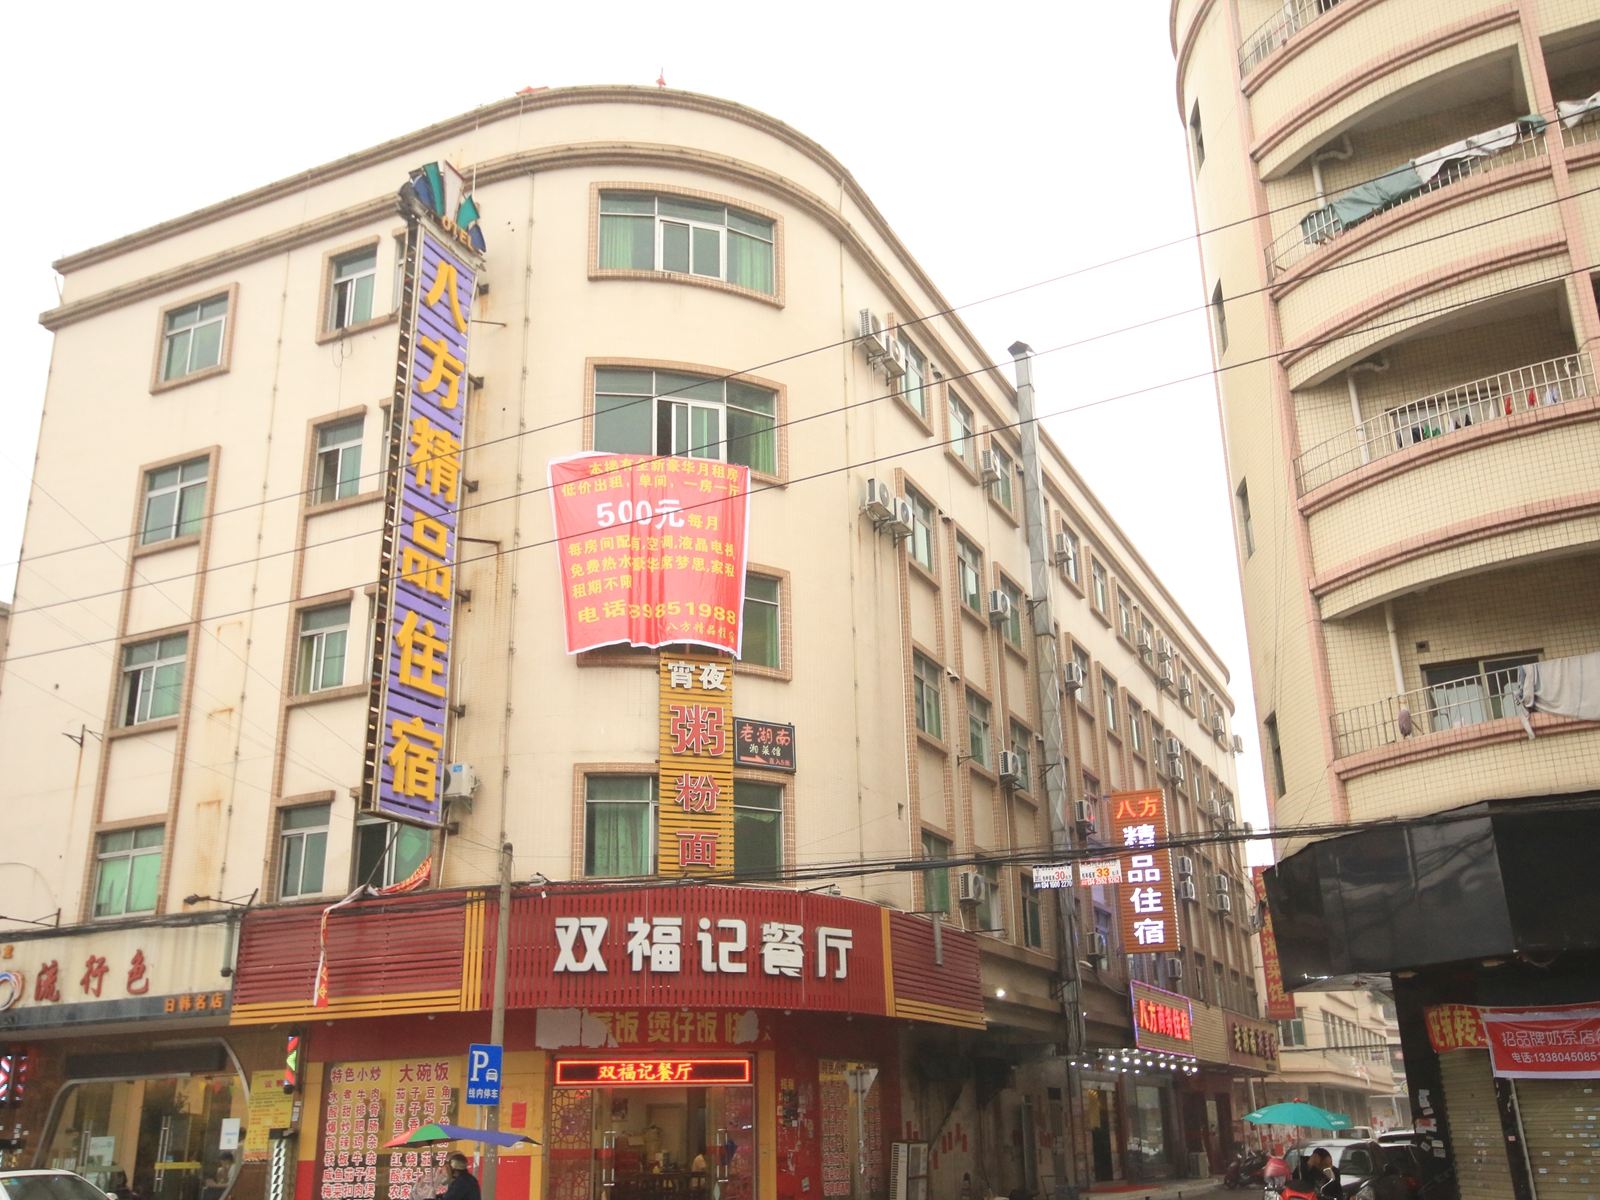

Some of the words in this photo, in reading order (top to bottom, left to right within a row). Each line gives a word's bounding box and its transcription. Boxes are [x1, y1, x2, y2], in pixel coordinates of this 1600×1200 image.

[388, 260, 467, 803] 八方精品住宿
[572, 575, 633, 599] 租期不限
[668, 661, 727, 691] 宵夜
[740, 723, 791, 746] 老湖南
[1116, 797, 1158, 819] 八方
[1123, 824, 1165, 945] 精品住宿
[553, 917, 853, 979] 双福记餐厅
[34, 949, 150, 1002] 流行色
[163, 992, 225, 1013] 日韩名店
[331, 1066, 381, 1083] 特色小炒
[399, 1062, 449, 1082] 大碗饭
[469, 1050, 489, 1082] P
[597, 1062, 693, 1082] 双福记餐厅
[468, 1087, 499, 1100] 线内停车
